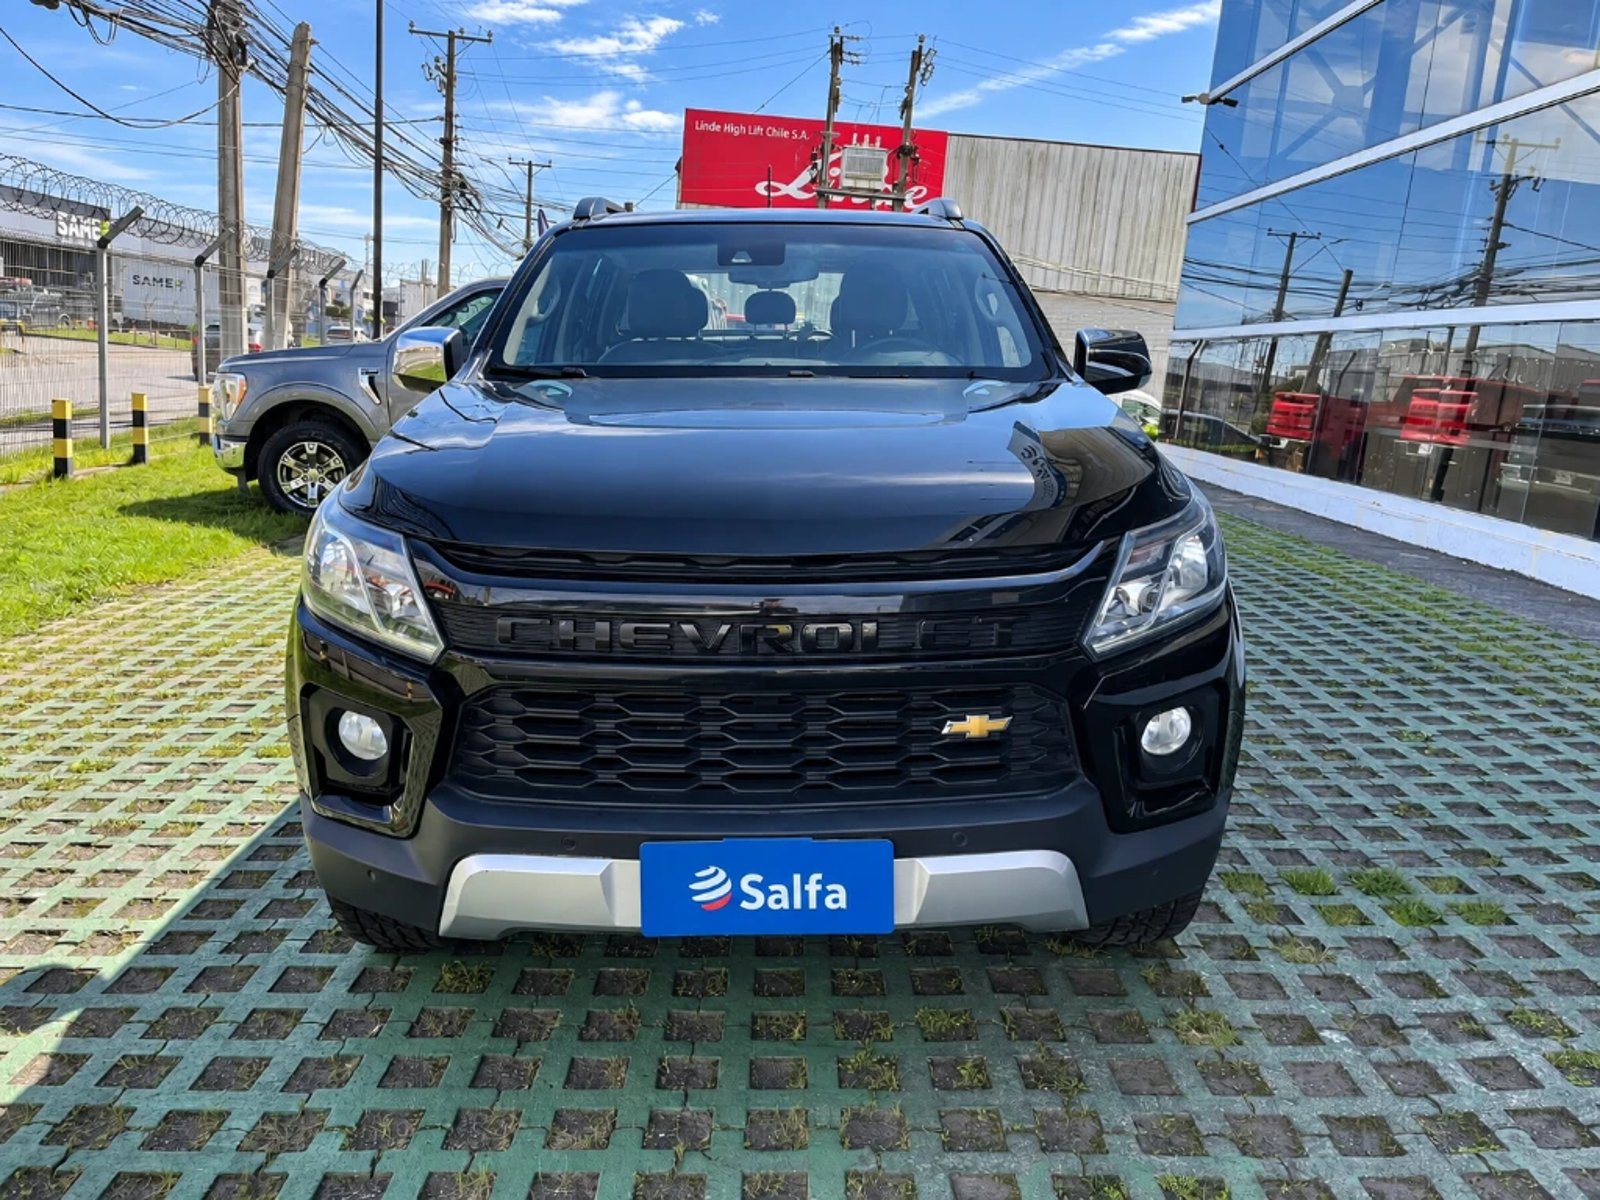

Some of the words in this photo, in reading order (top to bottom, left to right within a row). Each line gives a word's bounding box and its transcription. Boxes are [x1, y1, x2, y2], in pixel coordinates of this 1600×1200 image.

[694, 120, 721, 132] Linde
[723, 122, 746, 137] High
[747, 124, 764, 136] Lift
[765, 126, 790, 139] Chile
[791, 129, 811, 141] S.A.
[496, 615, 1027, 653] CHEVROLET
[739, 873, 848, 911] Salfa
